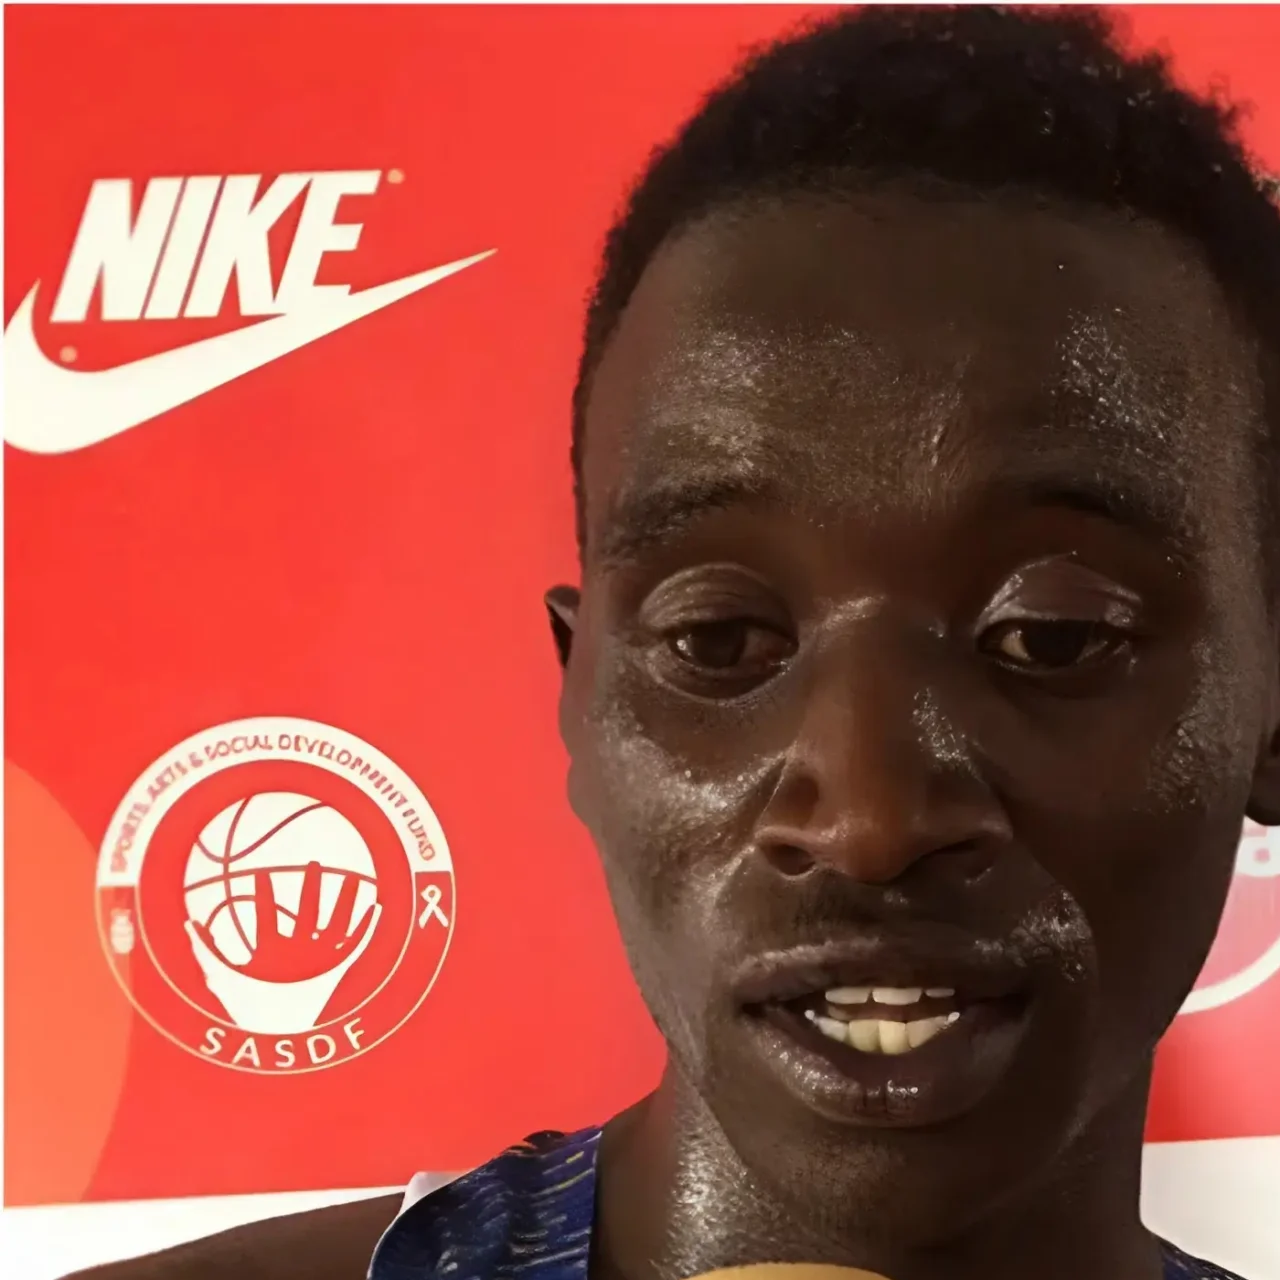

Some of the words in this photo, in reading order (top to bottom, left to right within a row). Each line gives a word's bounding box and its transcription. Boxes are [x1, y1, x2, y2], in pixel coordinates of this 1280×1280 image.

[49, 170, 382, 323] NIKE
[203, 735, 273, 760] SOCIAL
[278, 734, 408, 808] DEVELOPMENT
[402, 808, 436, 861] FUND
[200, 1017, 366, 1068] SASDF
